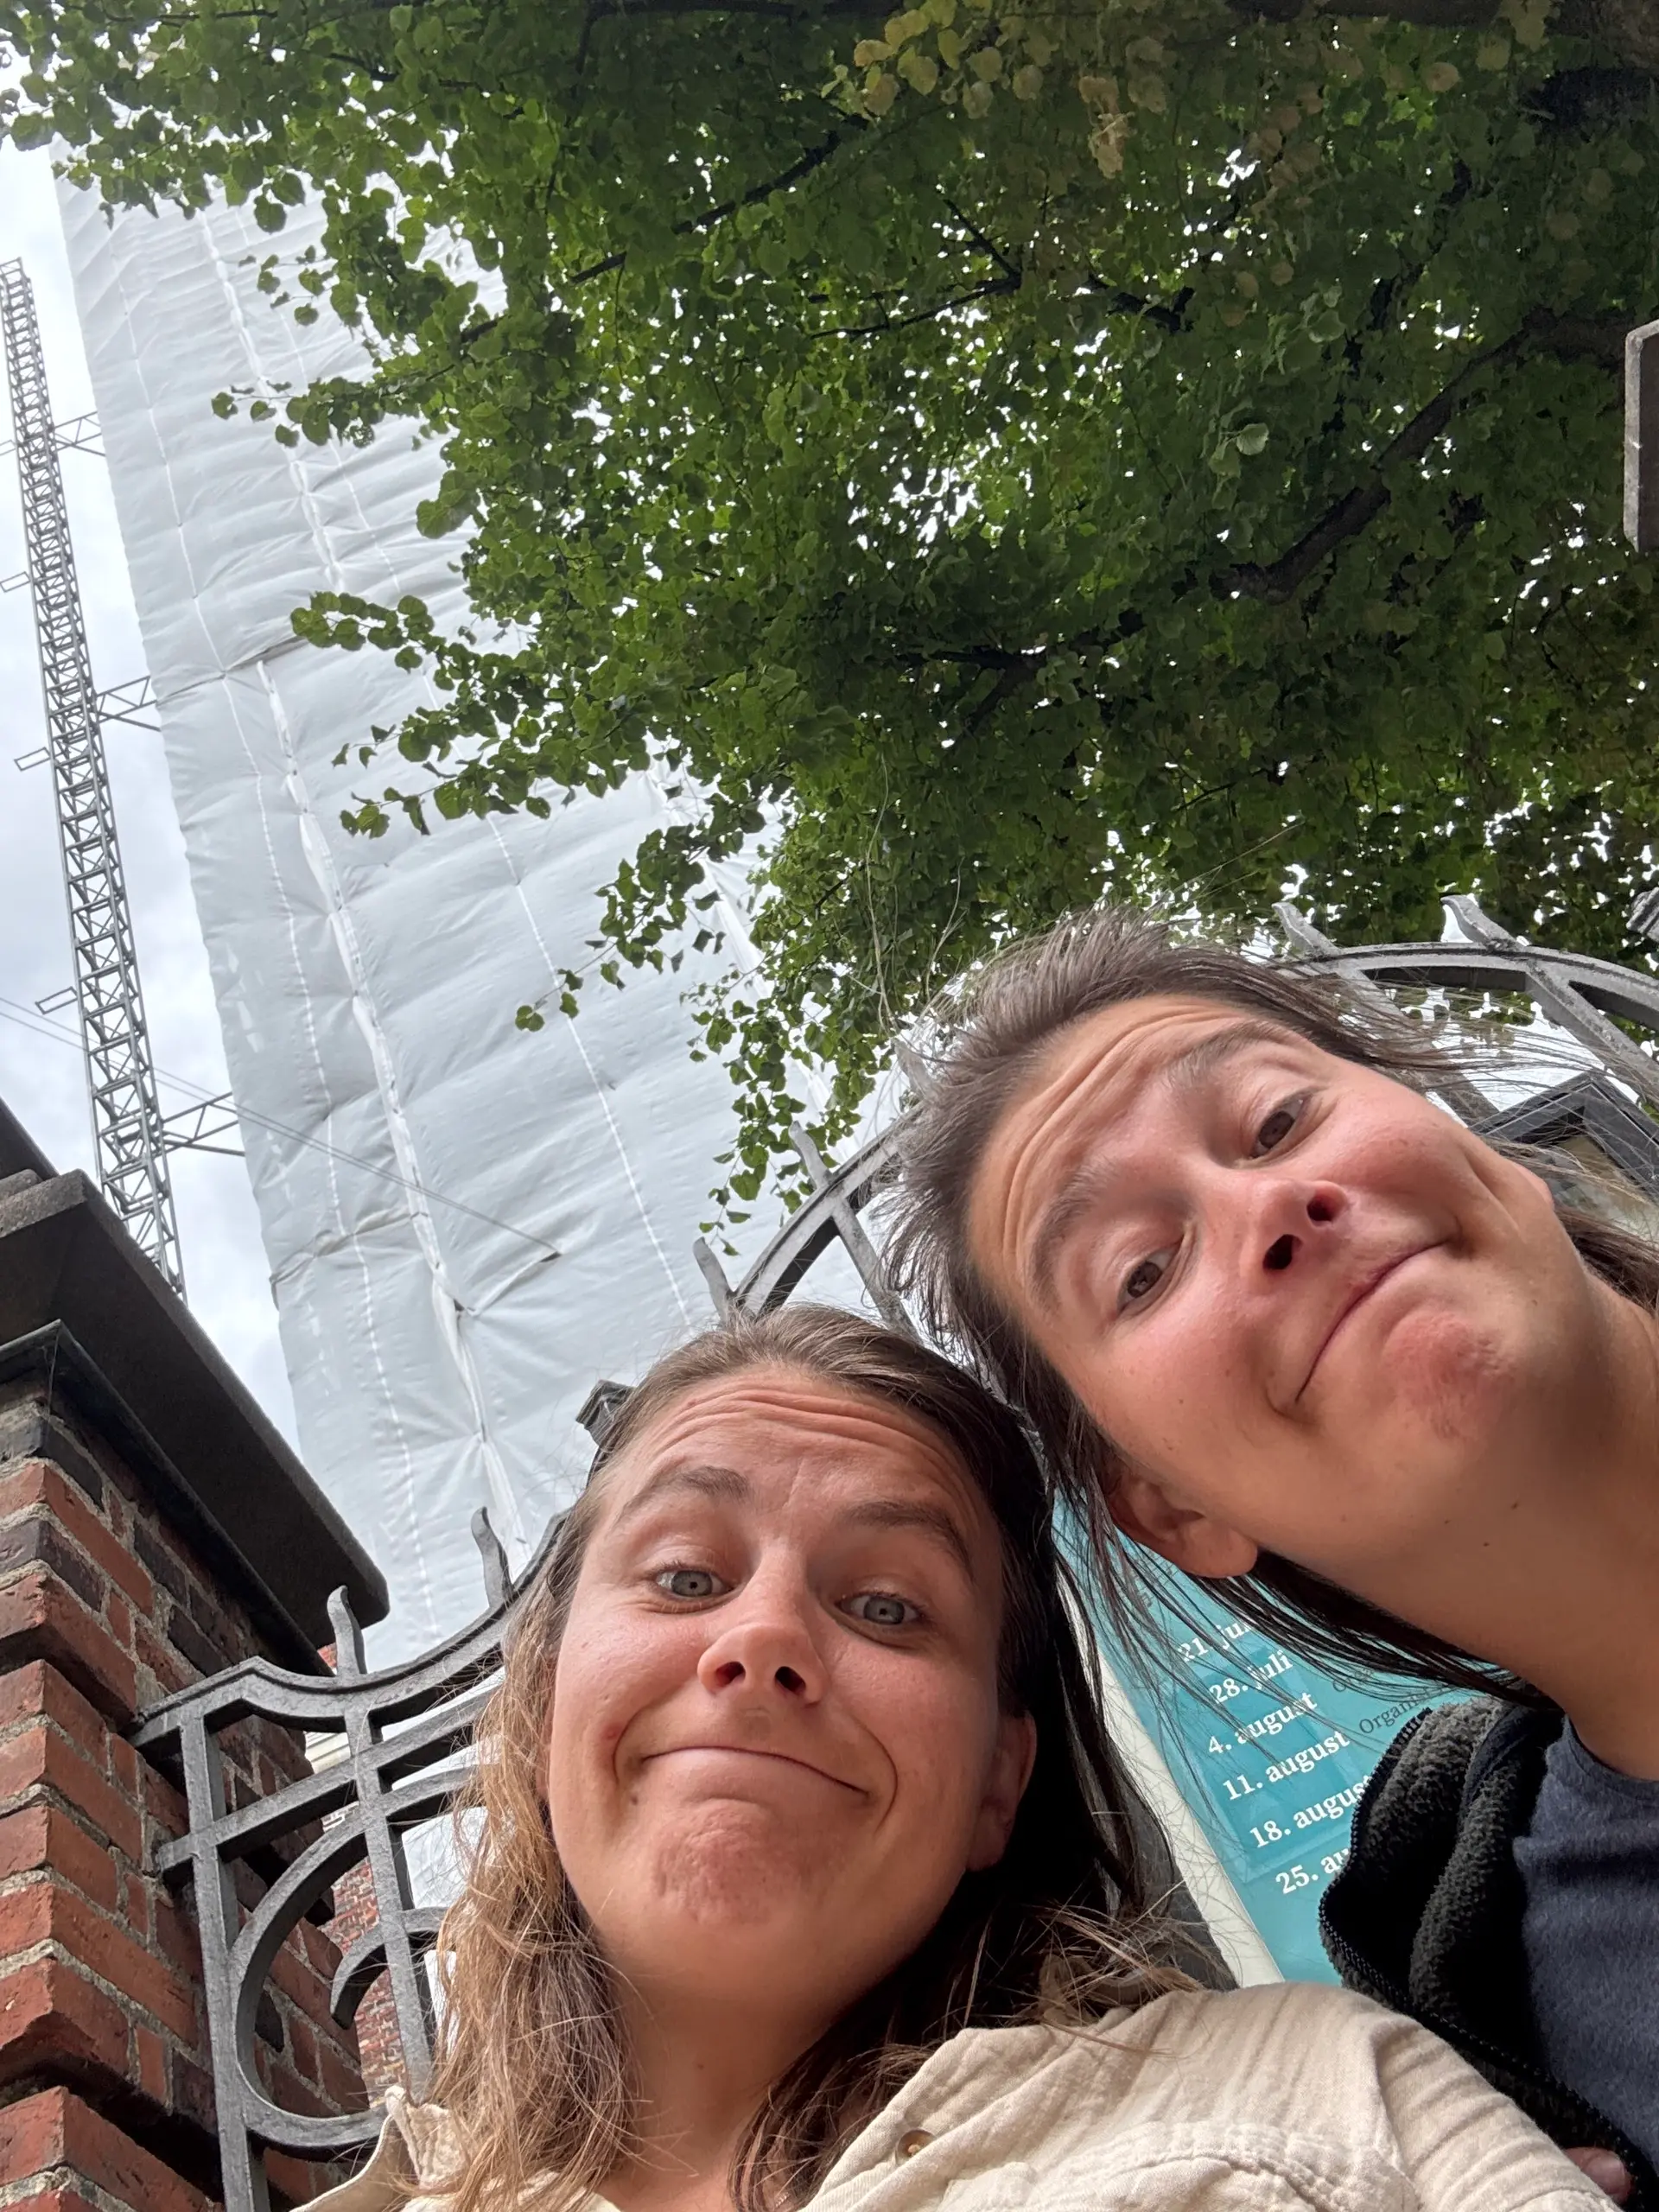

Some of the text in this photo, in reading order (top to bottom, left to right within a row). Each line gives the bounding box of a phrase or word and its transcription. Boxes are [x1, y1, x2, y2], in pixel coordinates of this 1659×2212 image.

[1210, 1678, 1249, 1704] 28.
[1247, 1649, 1294, 1690] juli
[1208, 1692, 1318, 1754] 4. august
[1223, 1731, 1351, 1801] 11. august
[1249, 1820, 1292, 1848] 18.
[1275, 1865, 1319, 1895] 25.
